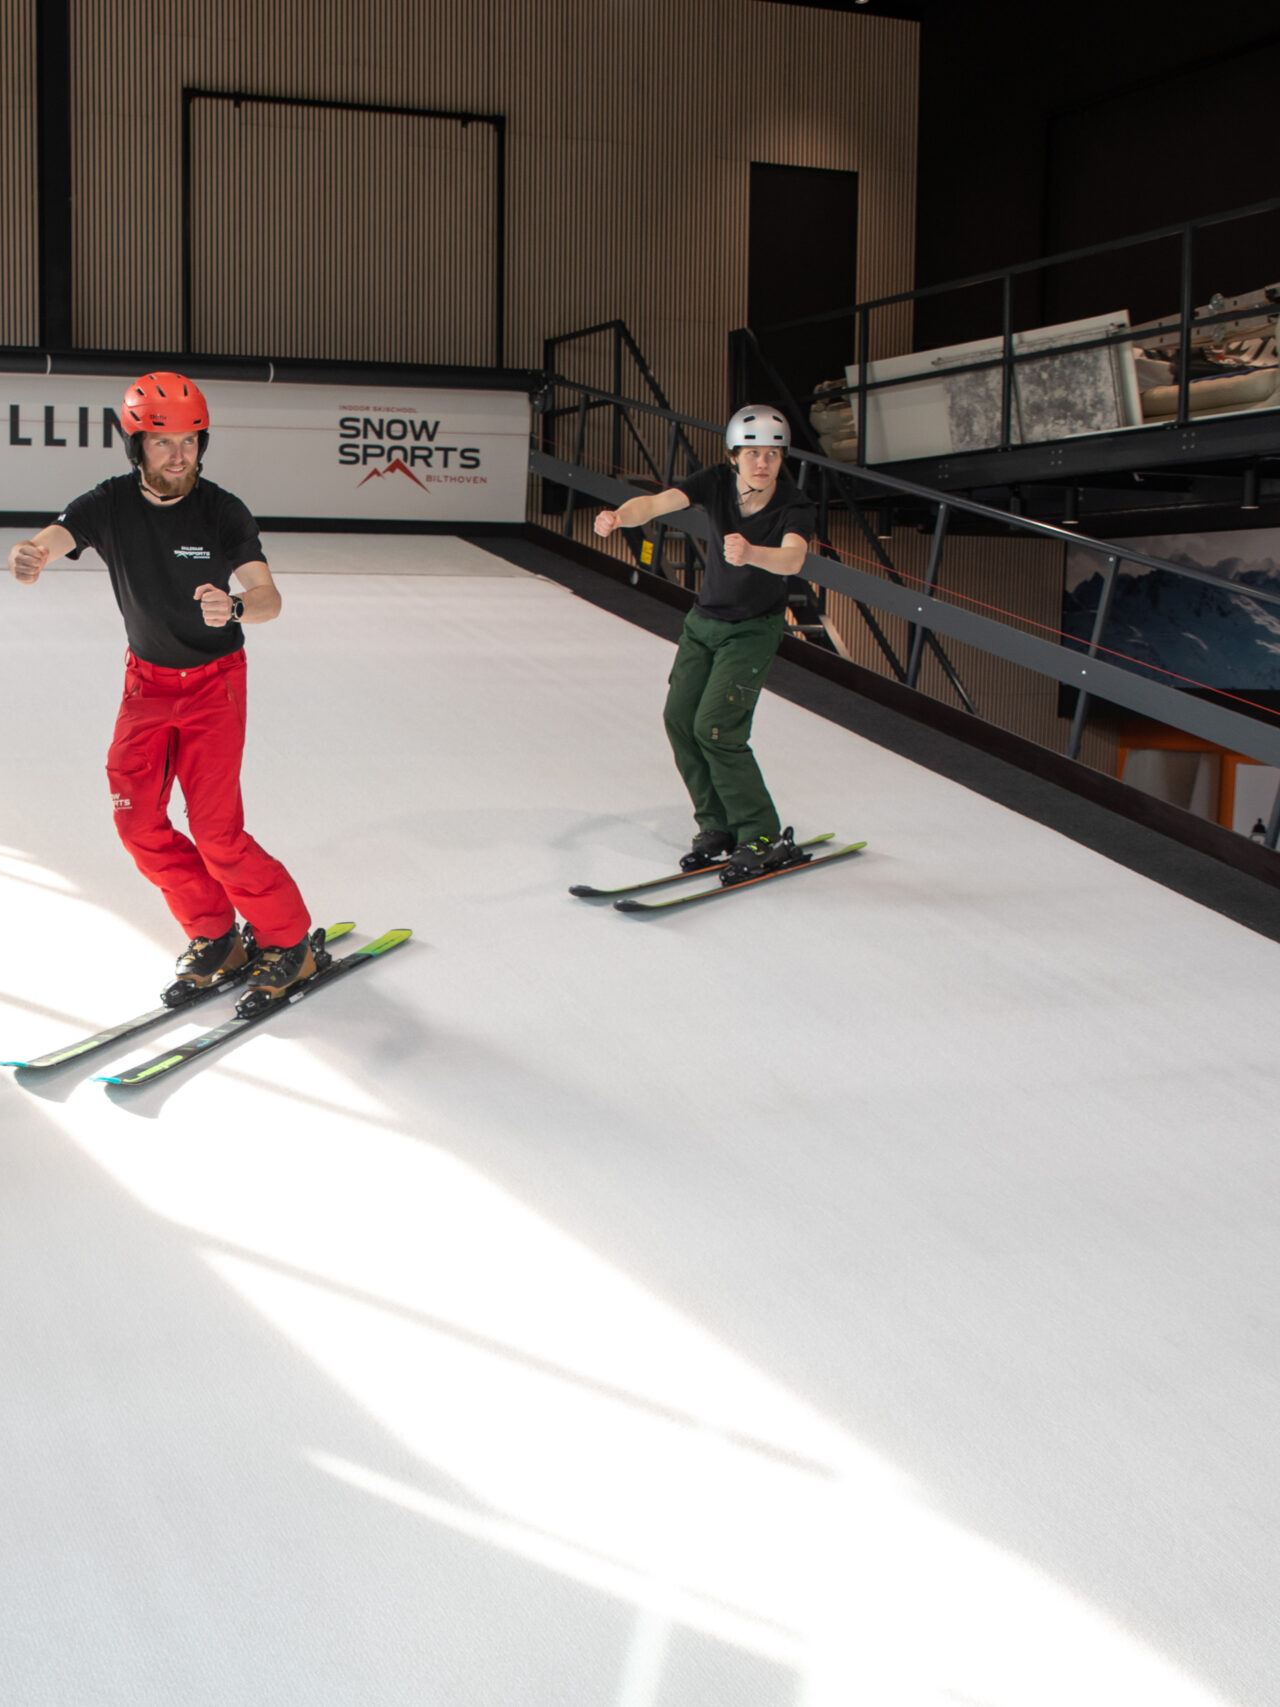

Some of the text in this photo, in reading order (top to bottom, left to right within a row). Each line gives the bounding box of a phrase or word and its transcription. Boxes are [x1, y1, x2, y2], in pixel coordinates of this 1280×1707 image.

[339, 416, 441, 442] SNOW
[338, 443, 481, 469] SPORTS
[426, 475, 487, 484] BILTHOVEN
